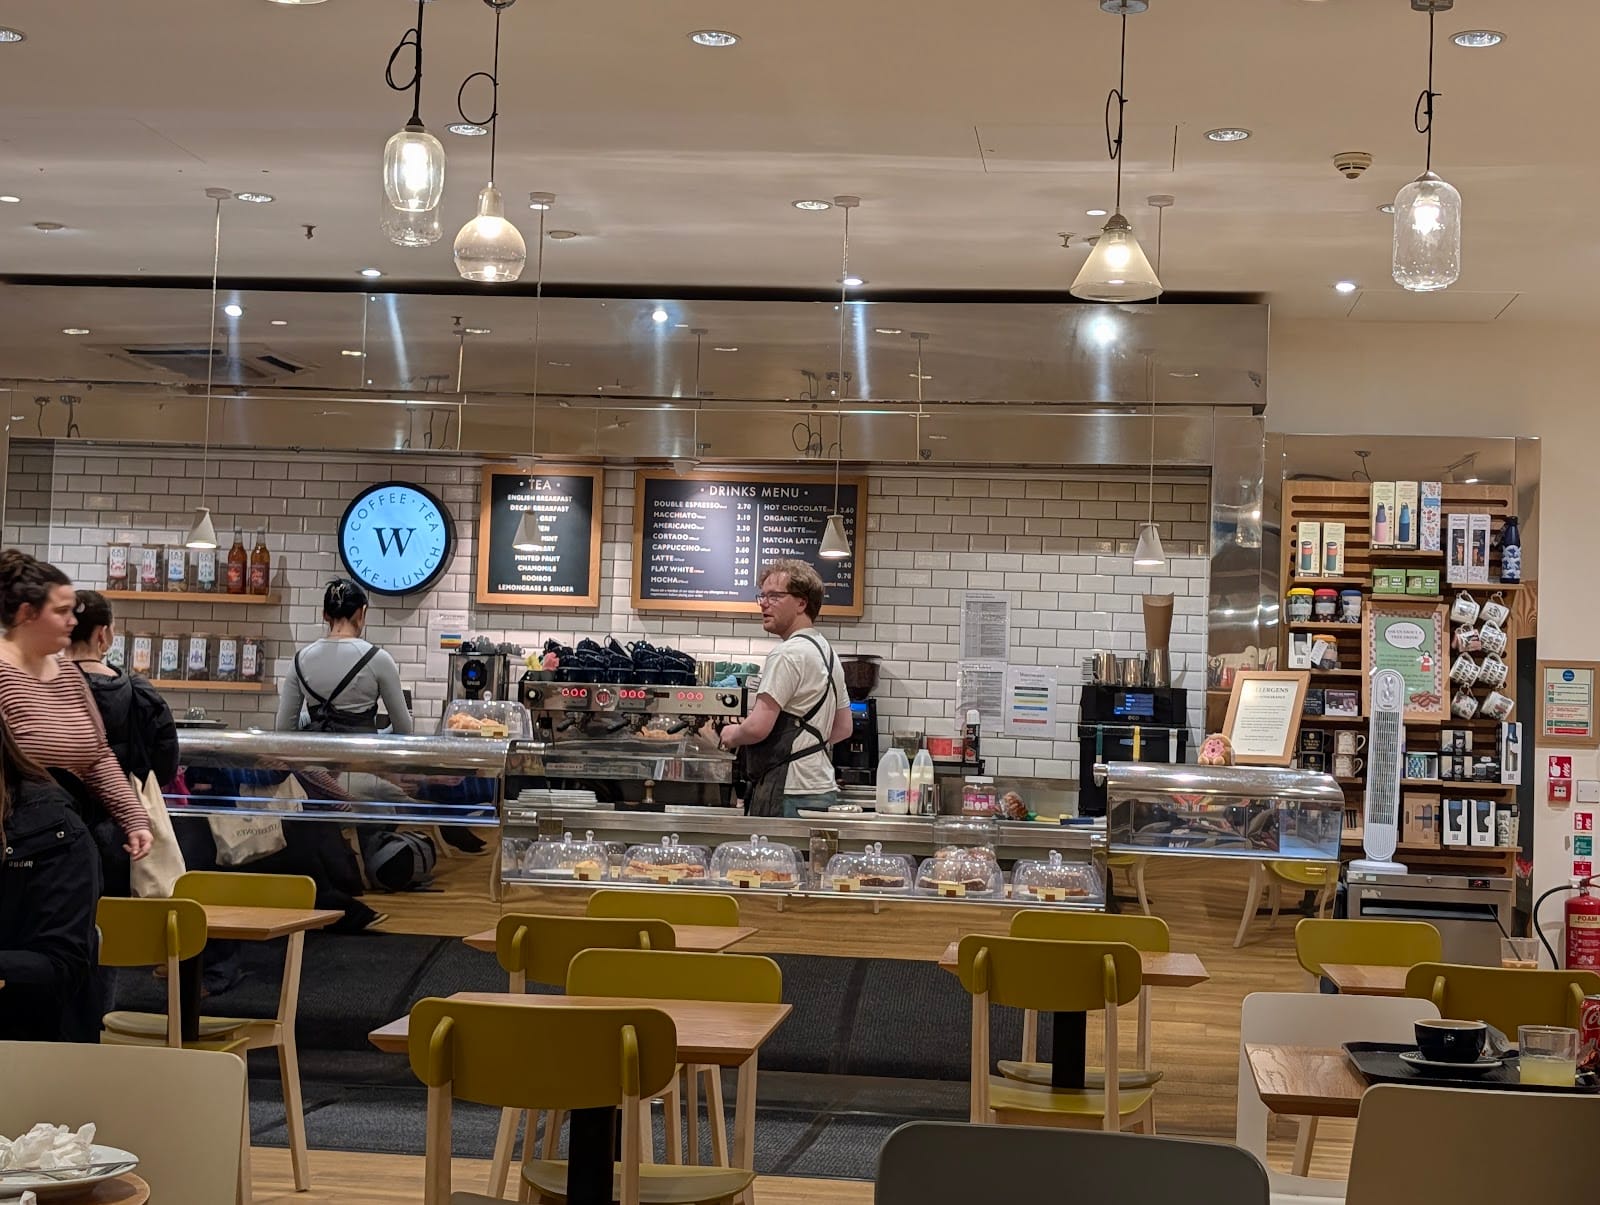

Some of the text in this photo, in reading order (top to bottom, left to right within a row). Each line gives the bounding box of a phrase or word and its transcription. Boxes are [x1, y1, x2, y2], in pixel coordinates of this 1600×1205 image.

[528, 480, 552, 490] TEA
[710, 485, 799, 498] DRINKS MENU
[350, 493, 406, 531] COFFEE
[418, 502, 439, 532] TEA
[372, 528, 417, 558] W
[349, 546, 380, 584] CAKE
[393, 546, 440, 588] LUNCH
